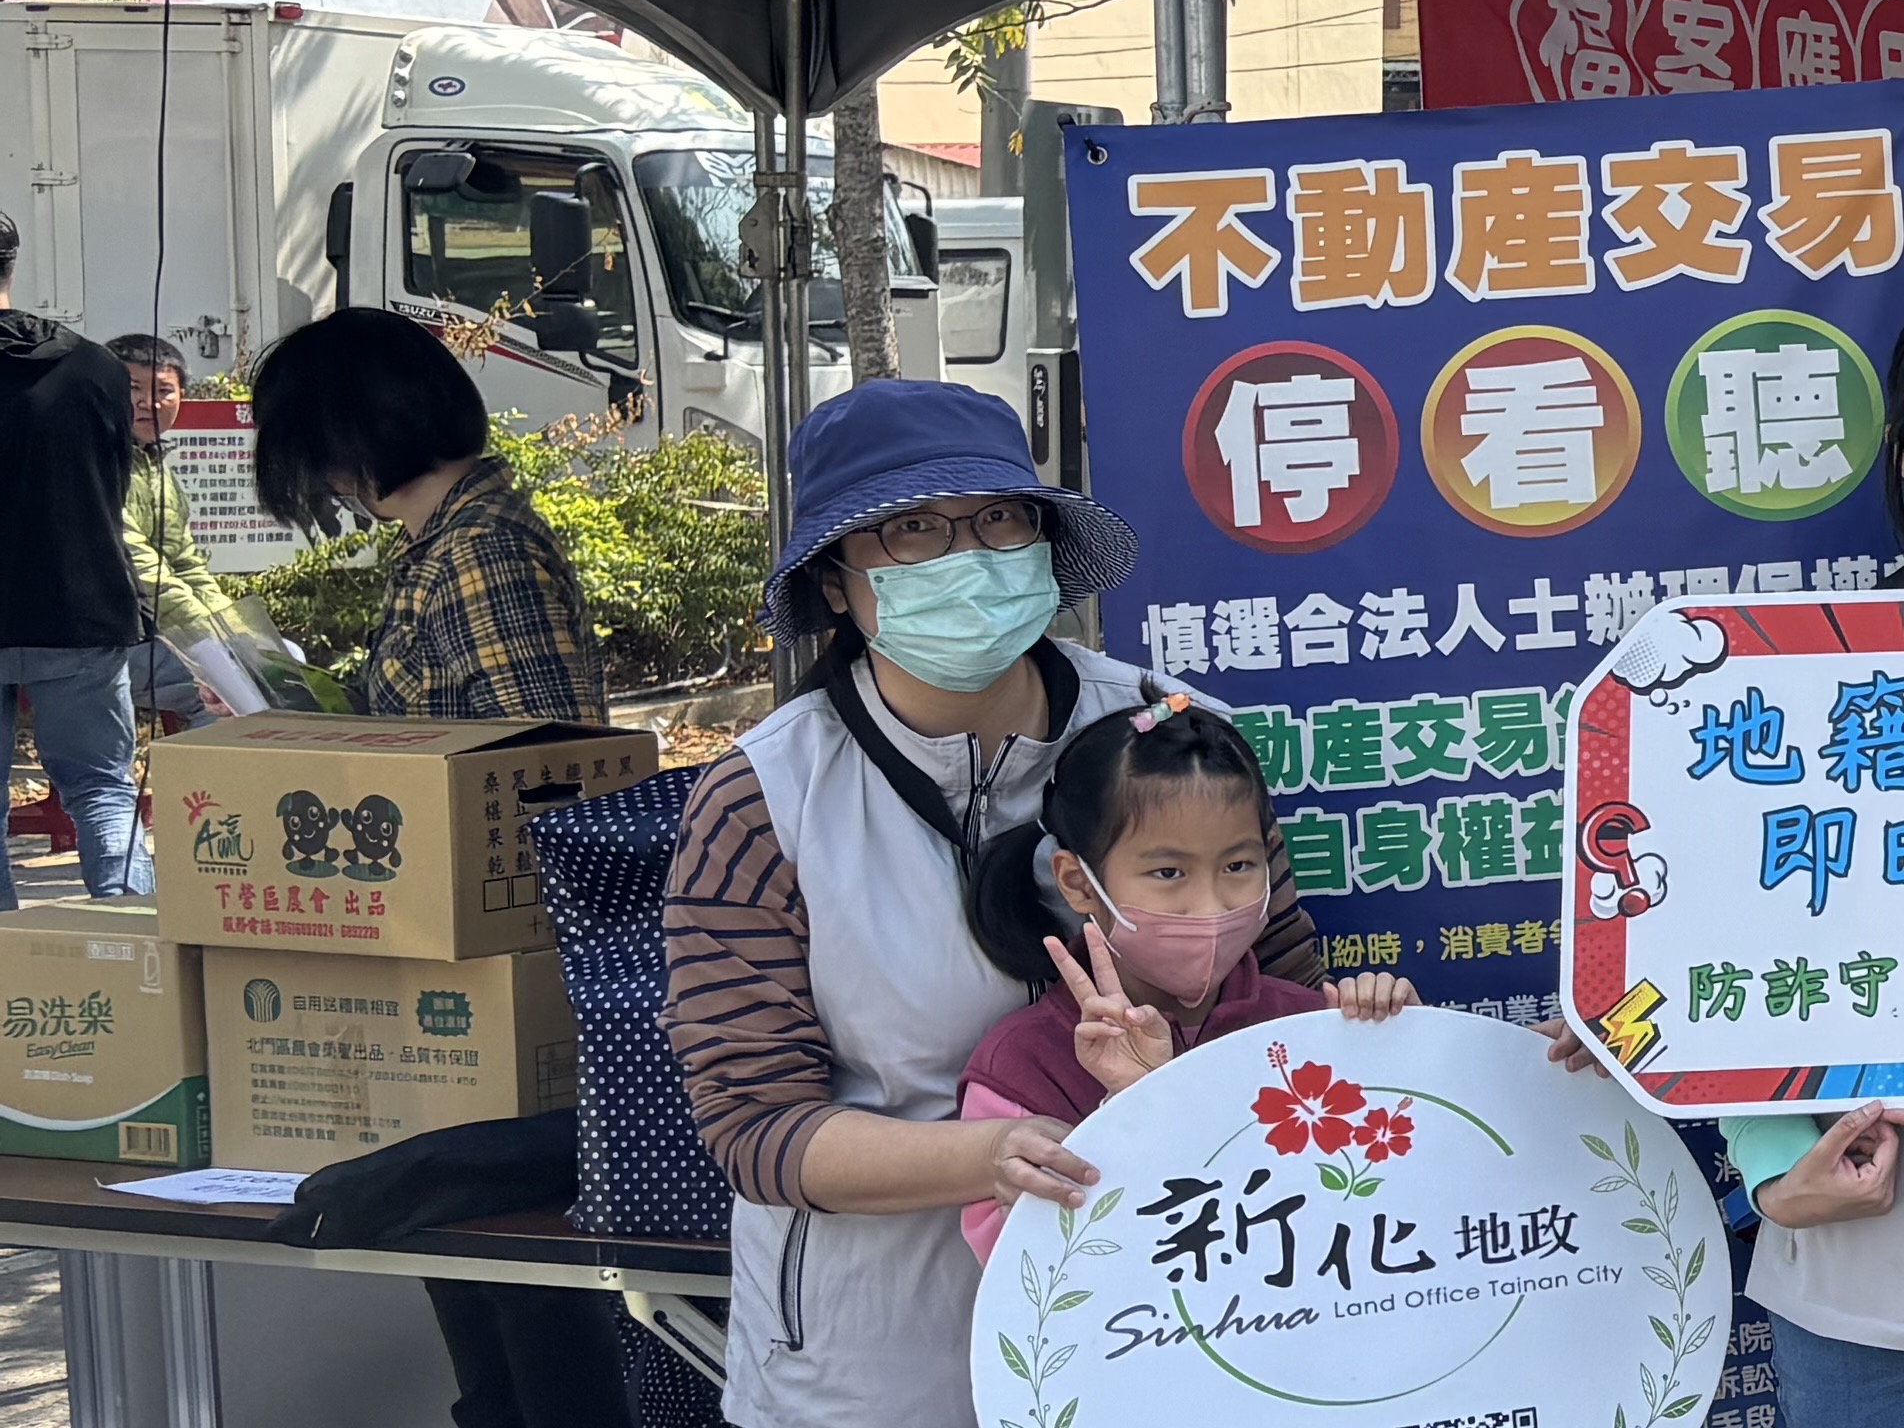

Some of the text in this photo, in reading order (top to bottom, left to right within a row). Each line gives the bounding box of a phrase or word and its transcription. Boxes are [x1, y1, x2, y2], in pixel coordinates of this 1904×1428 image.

[1130, 129, 1904, 316] 不動產交易
[1229, 682, 1578, 795] 動產交易
[1321, 919, 1561, 969] 紛時，消費者
[4, 989, 115, 1039] 易洗樂
[1137, 1169, 1582, 1289] 新化 地政
[1104, 1261, 1624, 1361] Sinhua Land Office Tainan City
